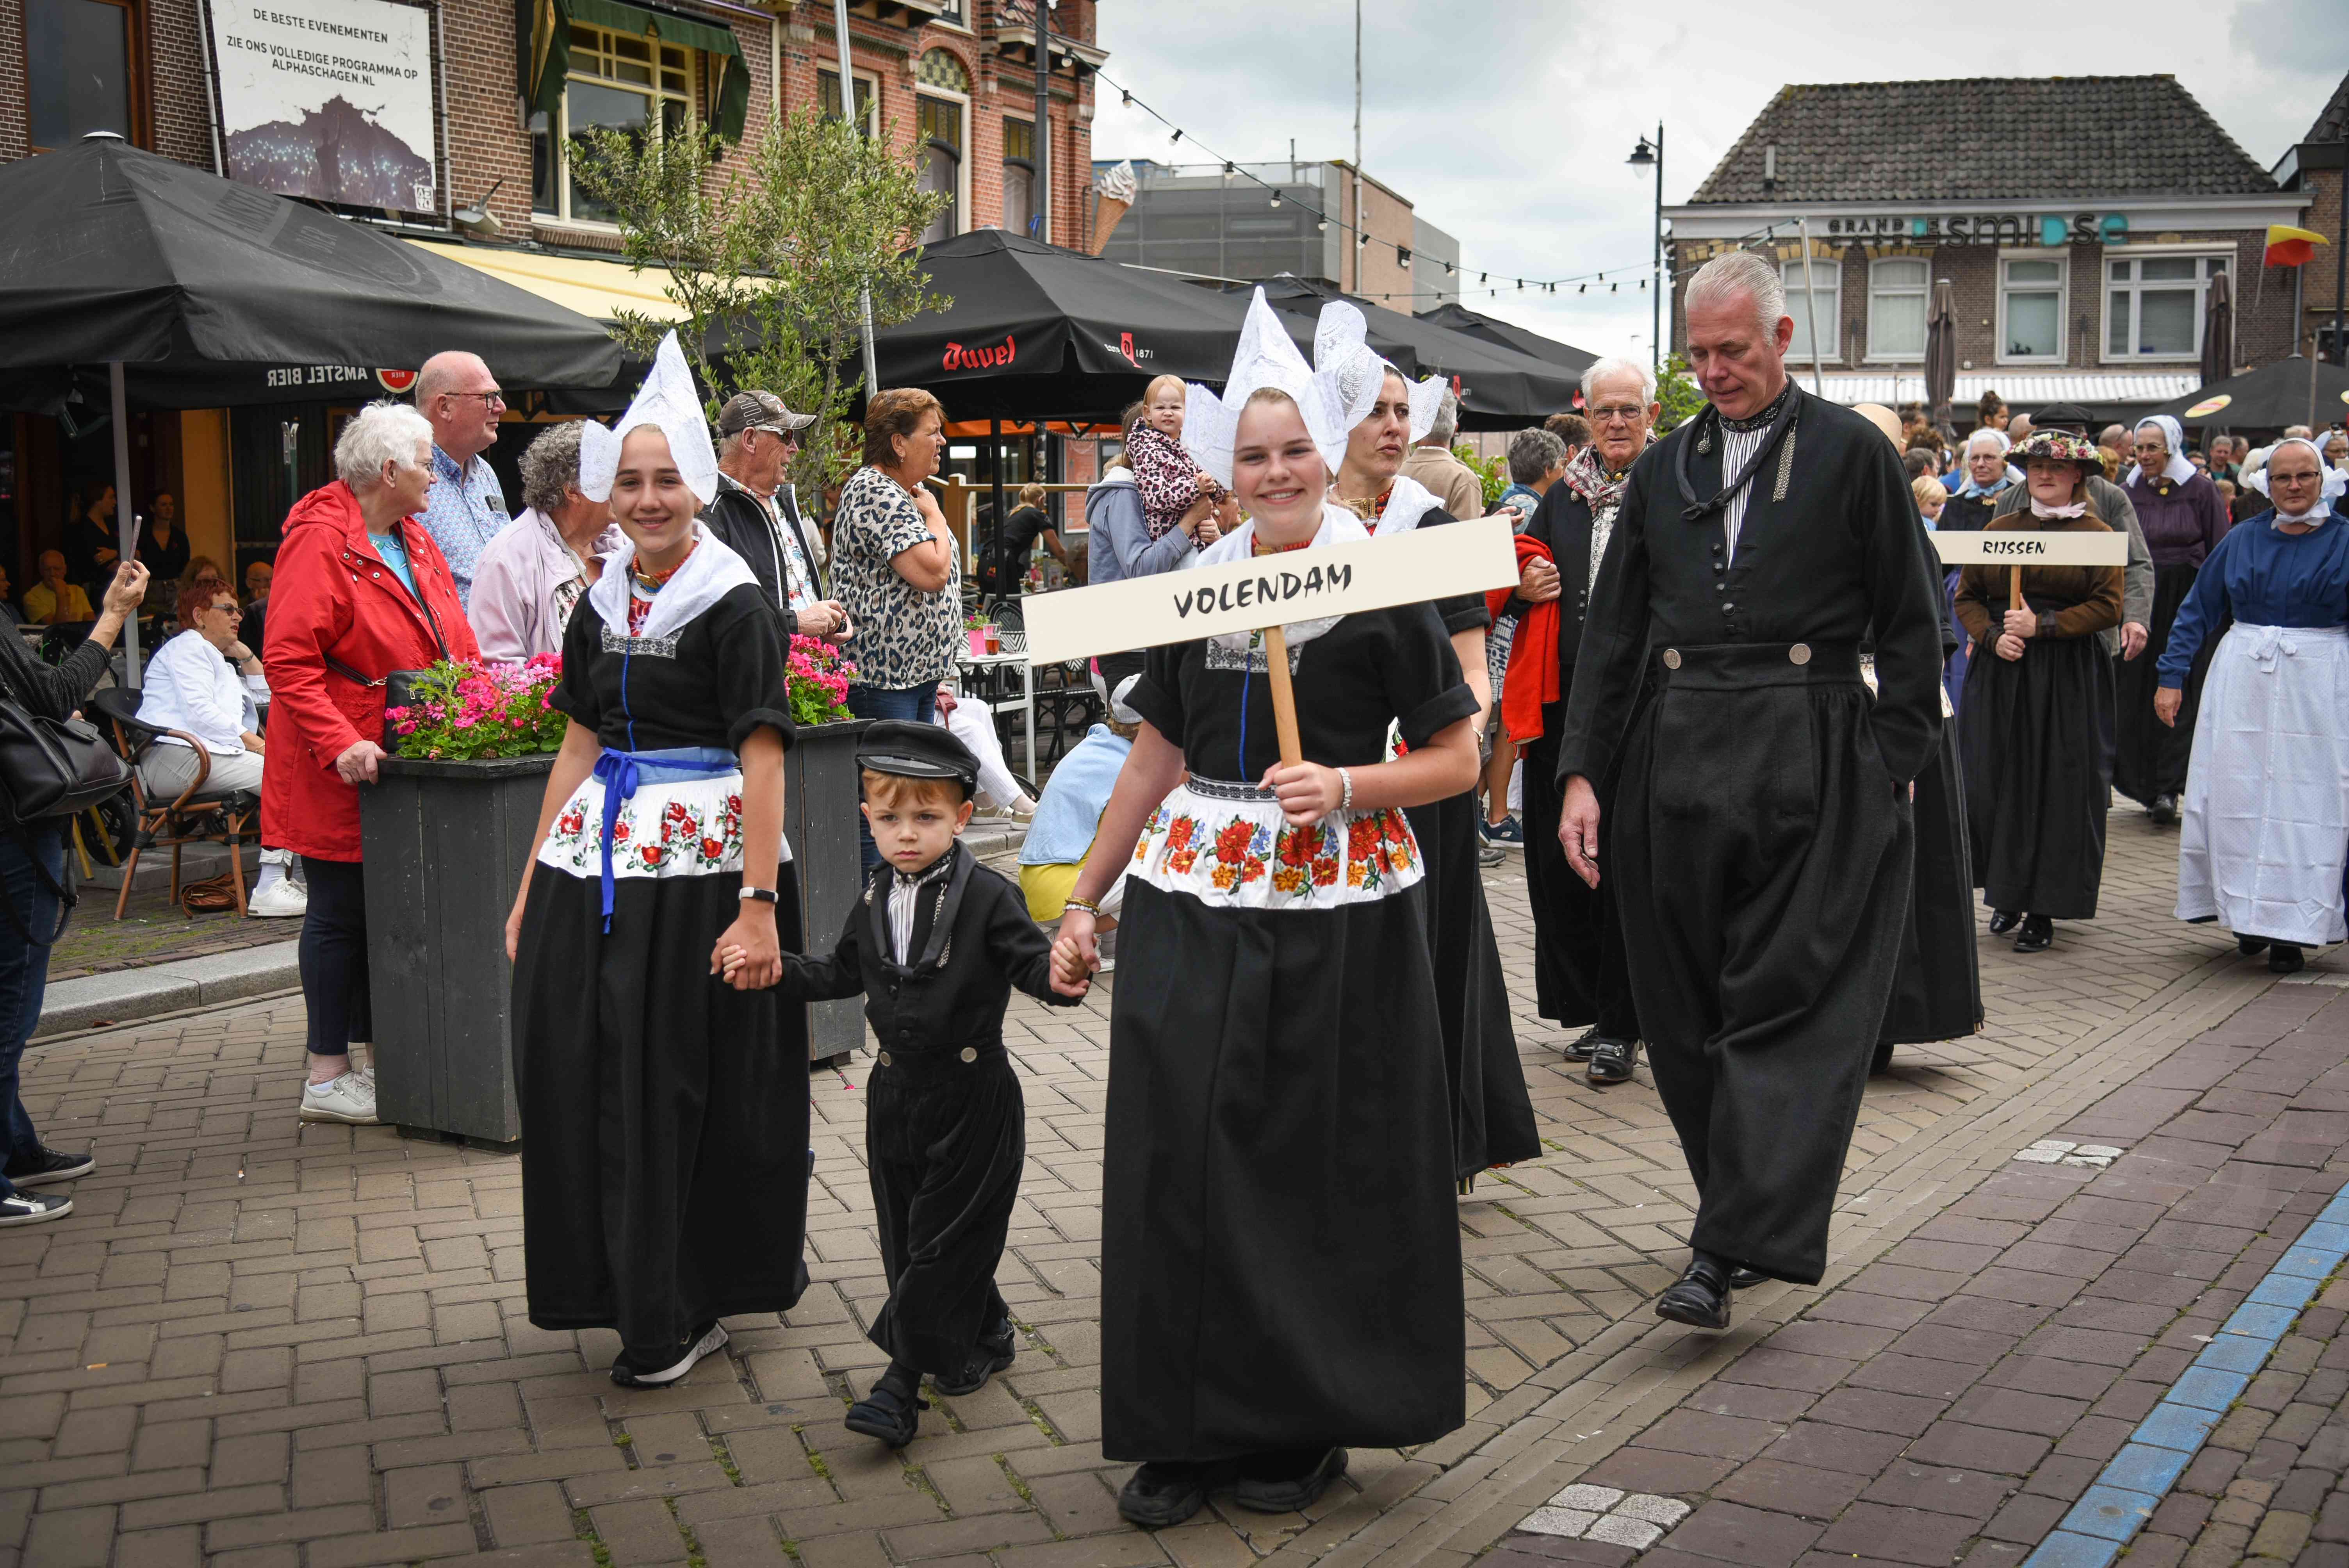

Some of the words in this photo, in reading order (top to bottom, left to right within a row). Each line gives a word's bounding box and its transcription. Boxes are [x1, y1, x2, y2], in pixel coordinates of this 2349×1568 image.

[253, 9, 268, 21] DE
[271, 12, 305, 29] BESTE
[308, 20, 388, 43] EVENEMENTEN
[226, 36, 243, 48] ZIE
[246, 40, 267, 53] ONS
[270, 45, 329, 65] VOLLEDIGE
[332, 57, 401, 77] PROGRAMMA
[404, 69, 418, 79] OP
[272, 59, 375, 86] ALPHASCHAGEN.NL
[1828, 219, 1903, 233] GRAND
[943, 335, 1015, 371] Duvel
[1136, 349, 1153, 359] 1871
[1983, 541, 2046, 554] RIJSSEN
[1174, 563, 1352, 619] VOLENDAM
